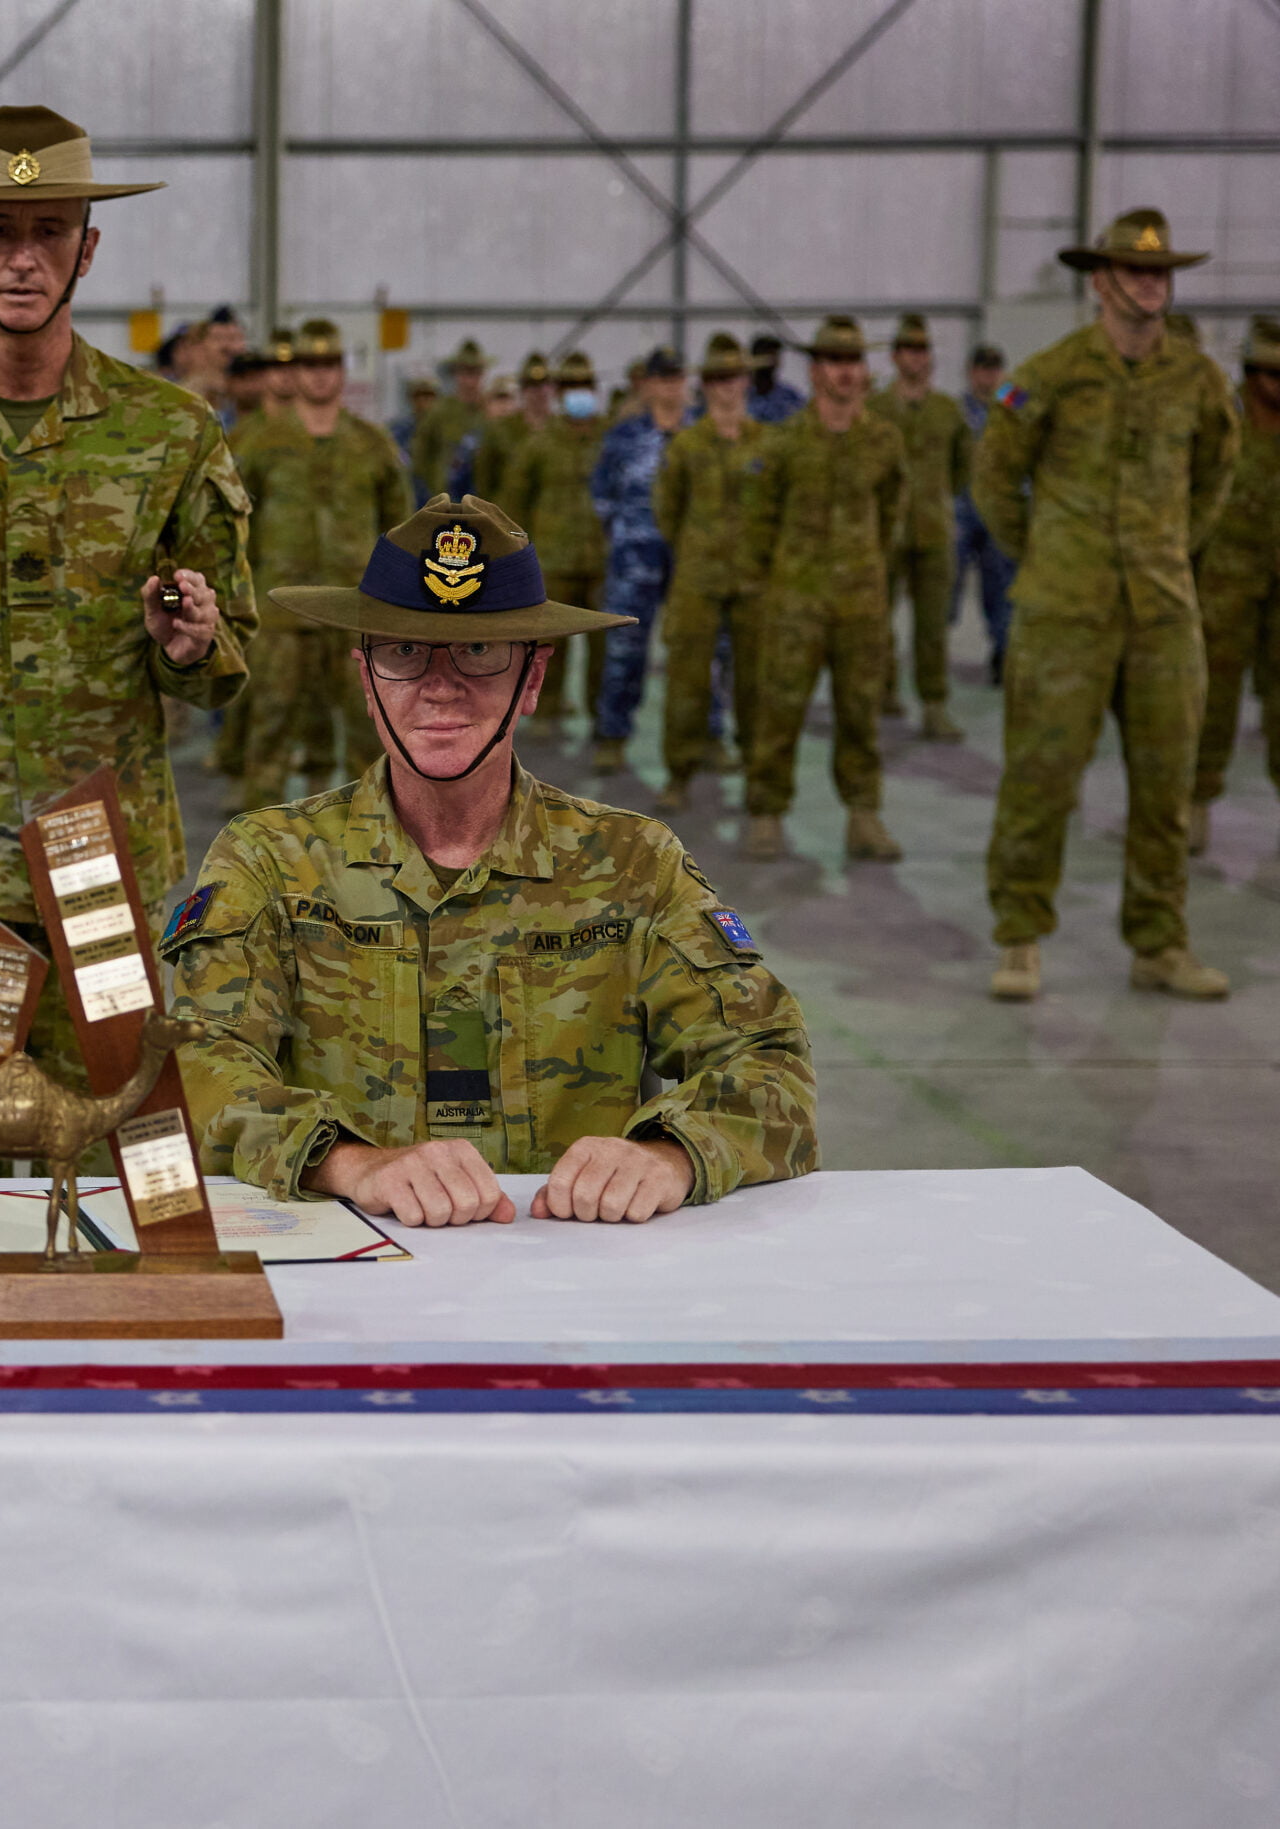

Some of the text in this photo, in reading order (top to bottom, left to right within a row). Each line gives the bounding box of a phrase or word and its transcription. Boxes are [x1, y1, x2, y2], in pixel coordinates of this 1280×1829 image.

[534, 922, 625, 950] AIR FORCE
[436, 1107, 485, 1118] AUSTRALIA
